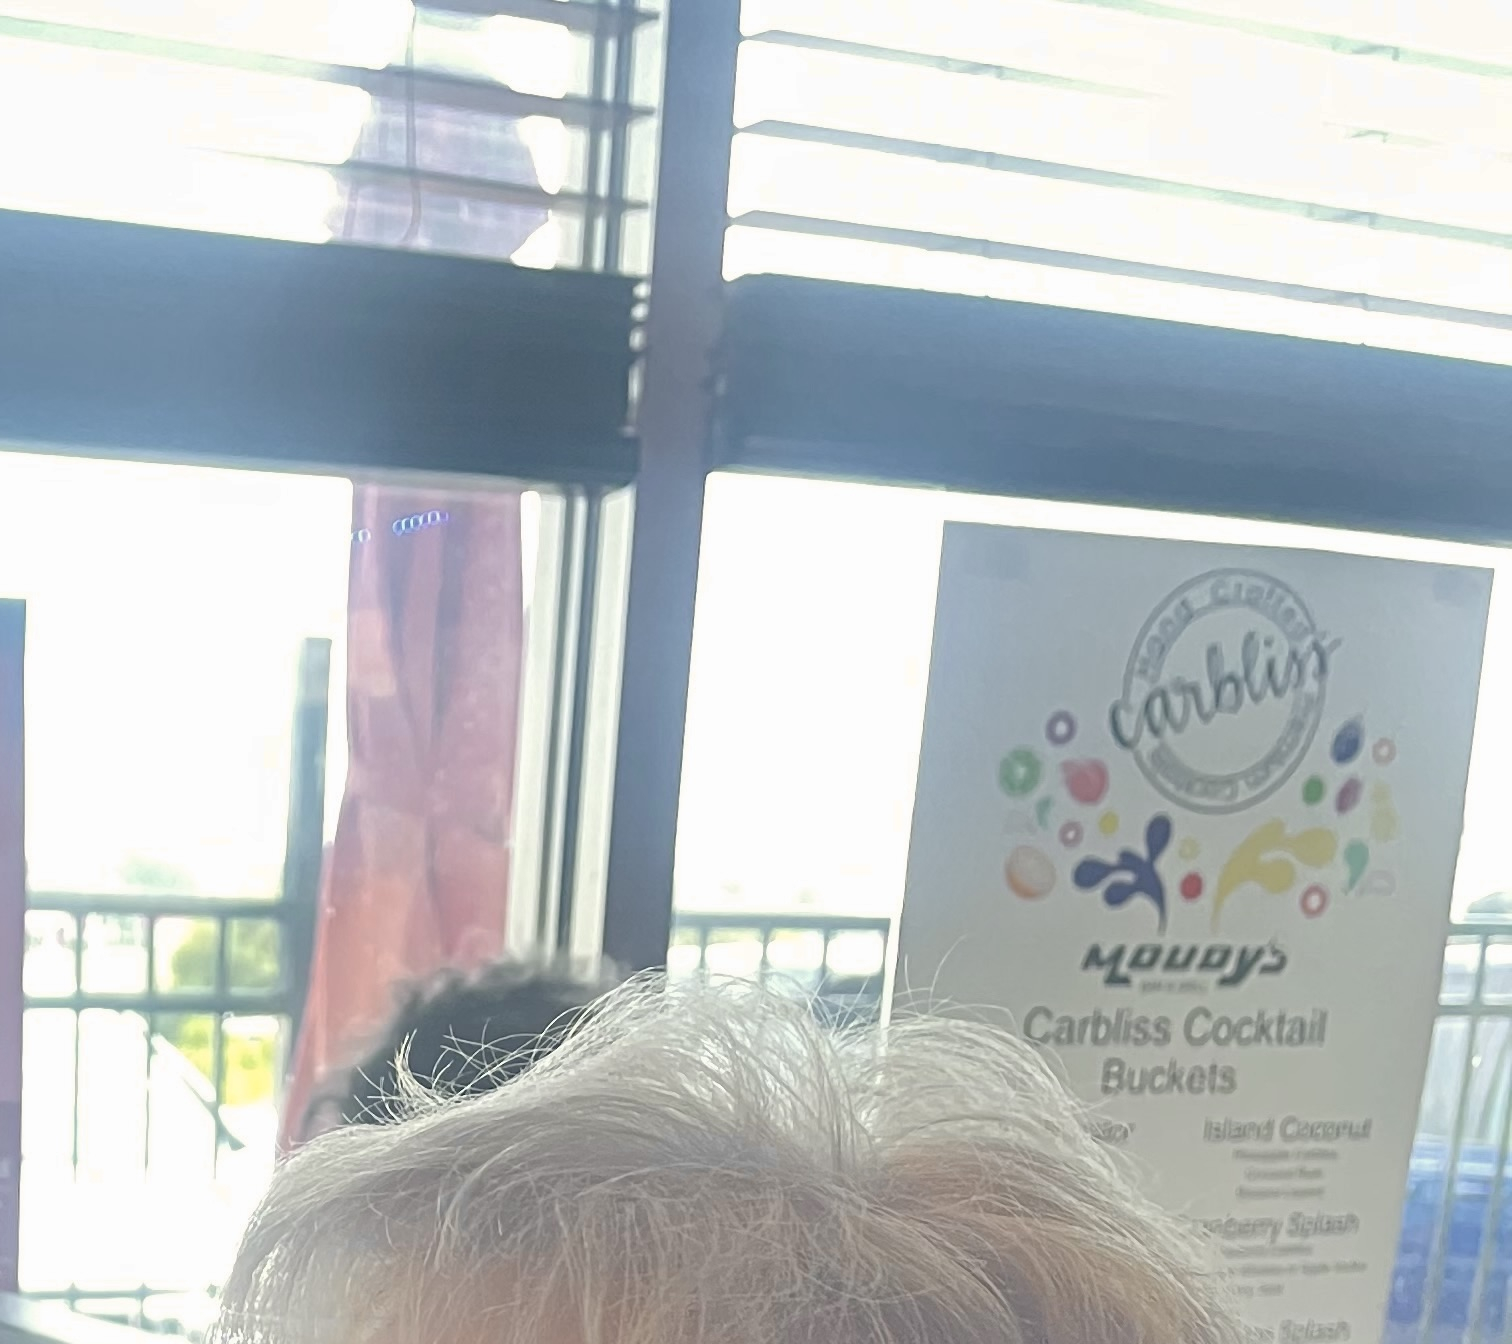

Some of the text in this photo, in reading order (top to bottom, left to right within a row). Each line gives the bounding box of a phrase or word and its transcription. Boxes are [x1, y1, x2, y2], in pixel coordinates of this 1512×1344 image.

[1109, 629, 1343, 750] Carbliss
[1023, 1005, 1329, 1047] Carbliss Cocktail
[1100, 1056, 1238, 1096] Buckets
[1203, 1116, 1275, 1142] Island
[1287, 1211, 1360, 1238] Splash
